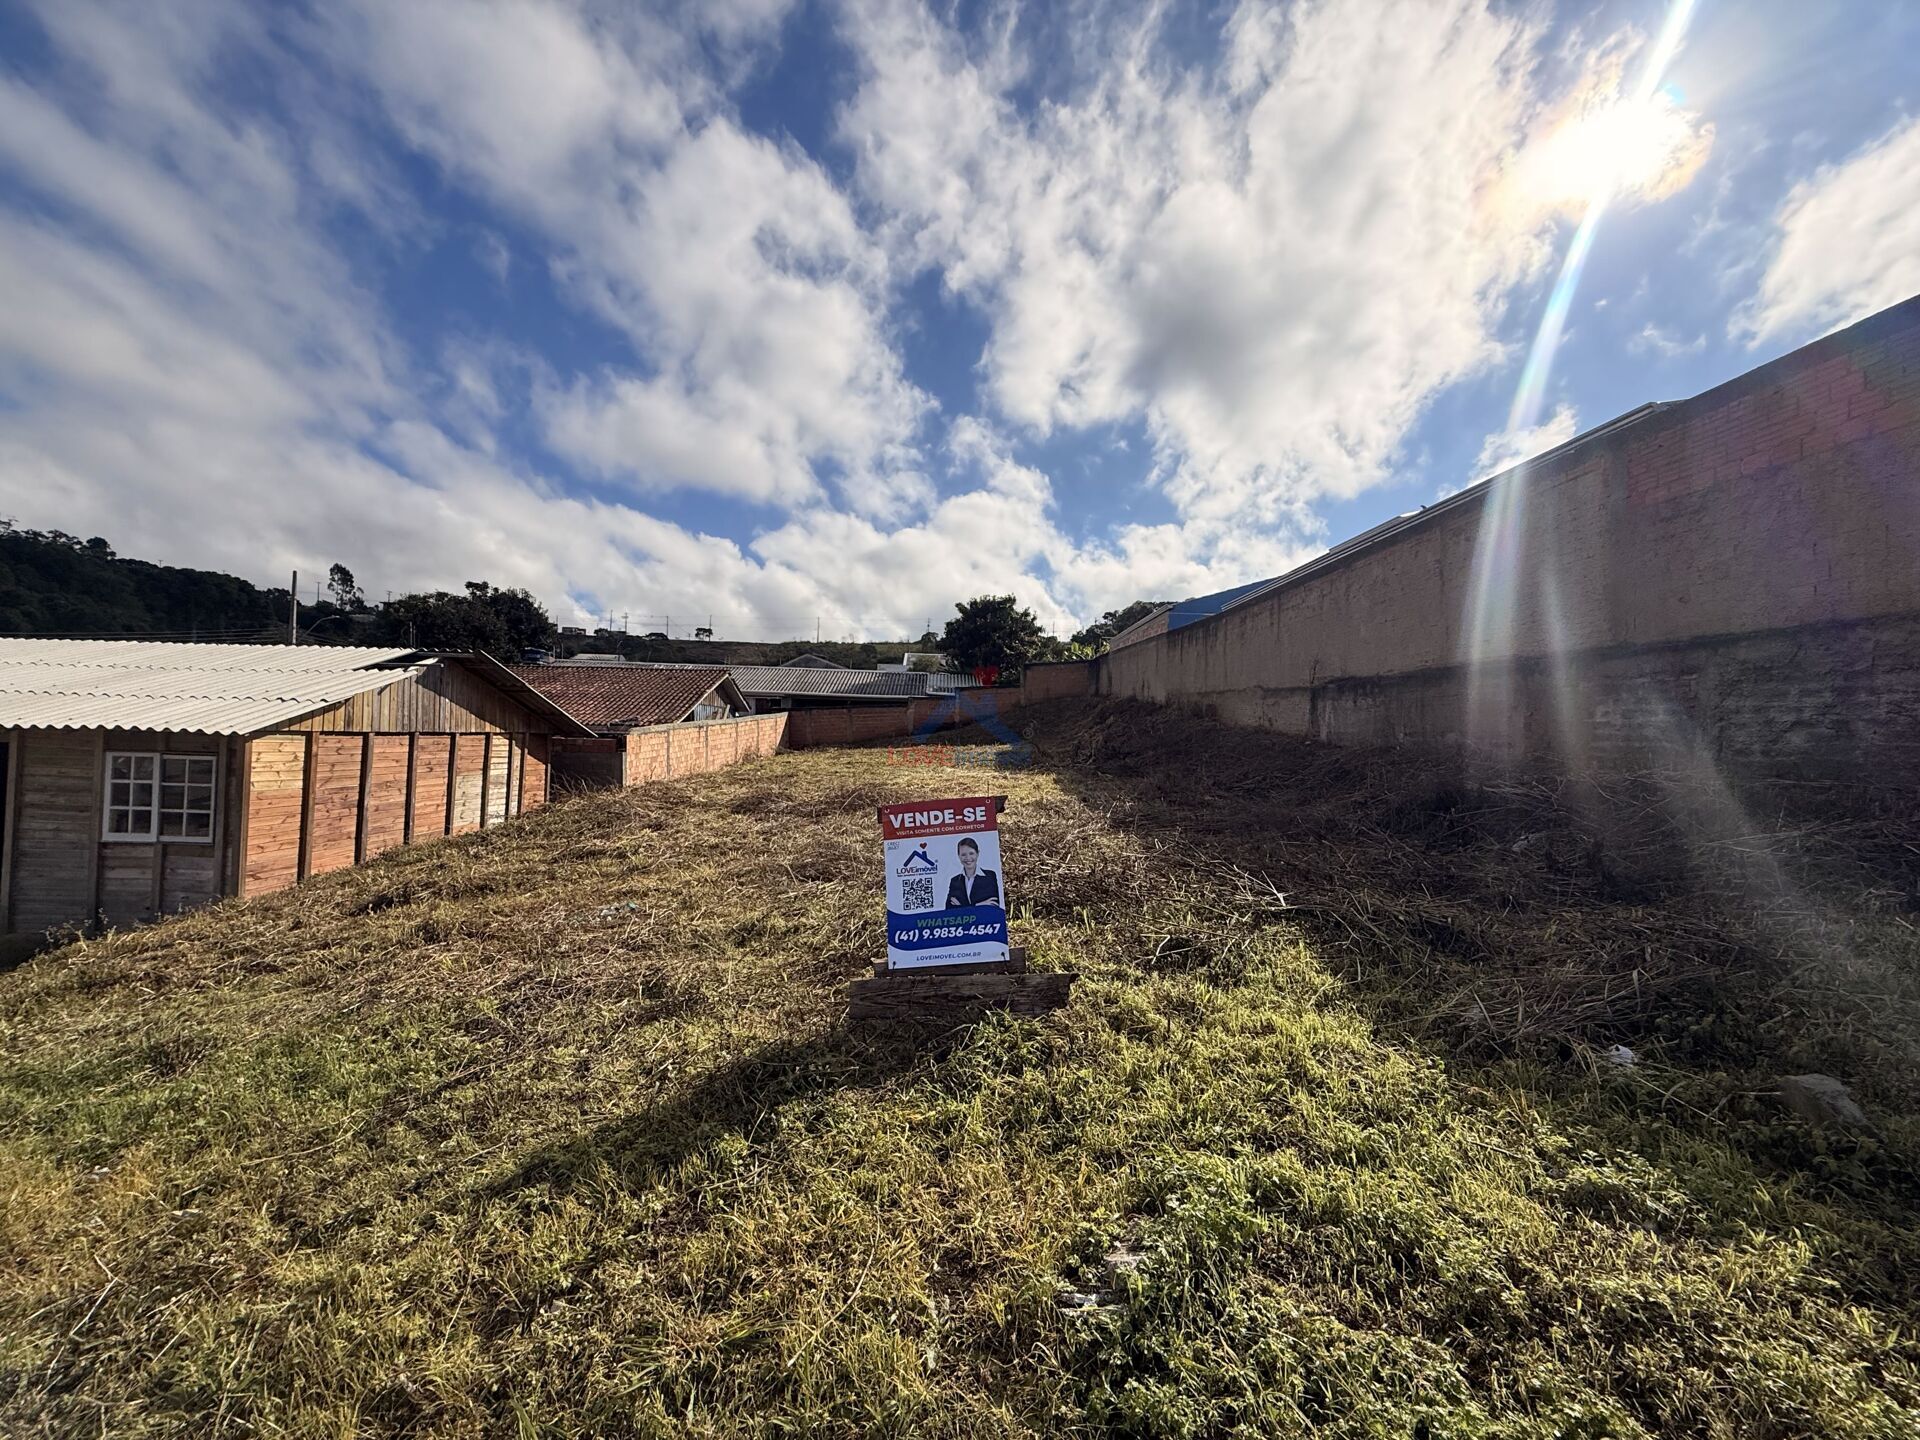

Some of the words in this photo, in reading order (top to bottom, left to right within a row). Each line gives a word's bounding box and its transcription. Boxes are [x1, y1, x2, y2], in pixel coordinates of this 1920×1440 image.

[889, 806, 987, 829] VENDE-SE
[955, 823, 985, 831] CORRETOR
[917, 915, 977, 928] WHATSAPP
[895, 929, 919, 943] (41)
[922, 923, 1001, 940] 9.9836-4547
